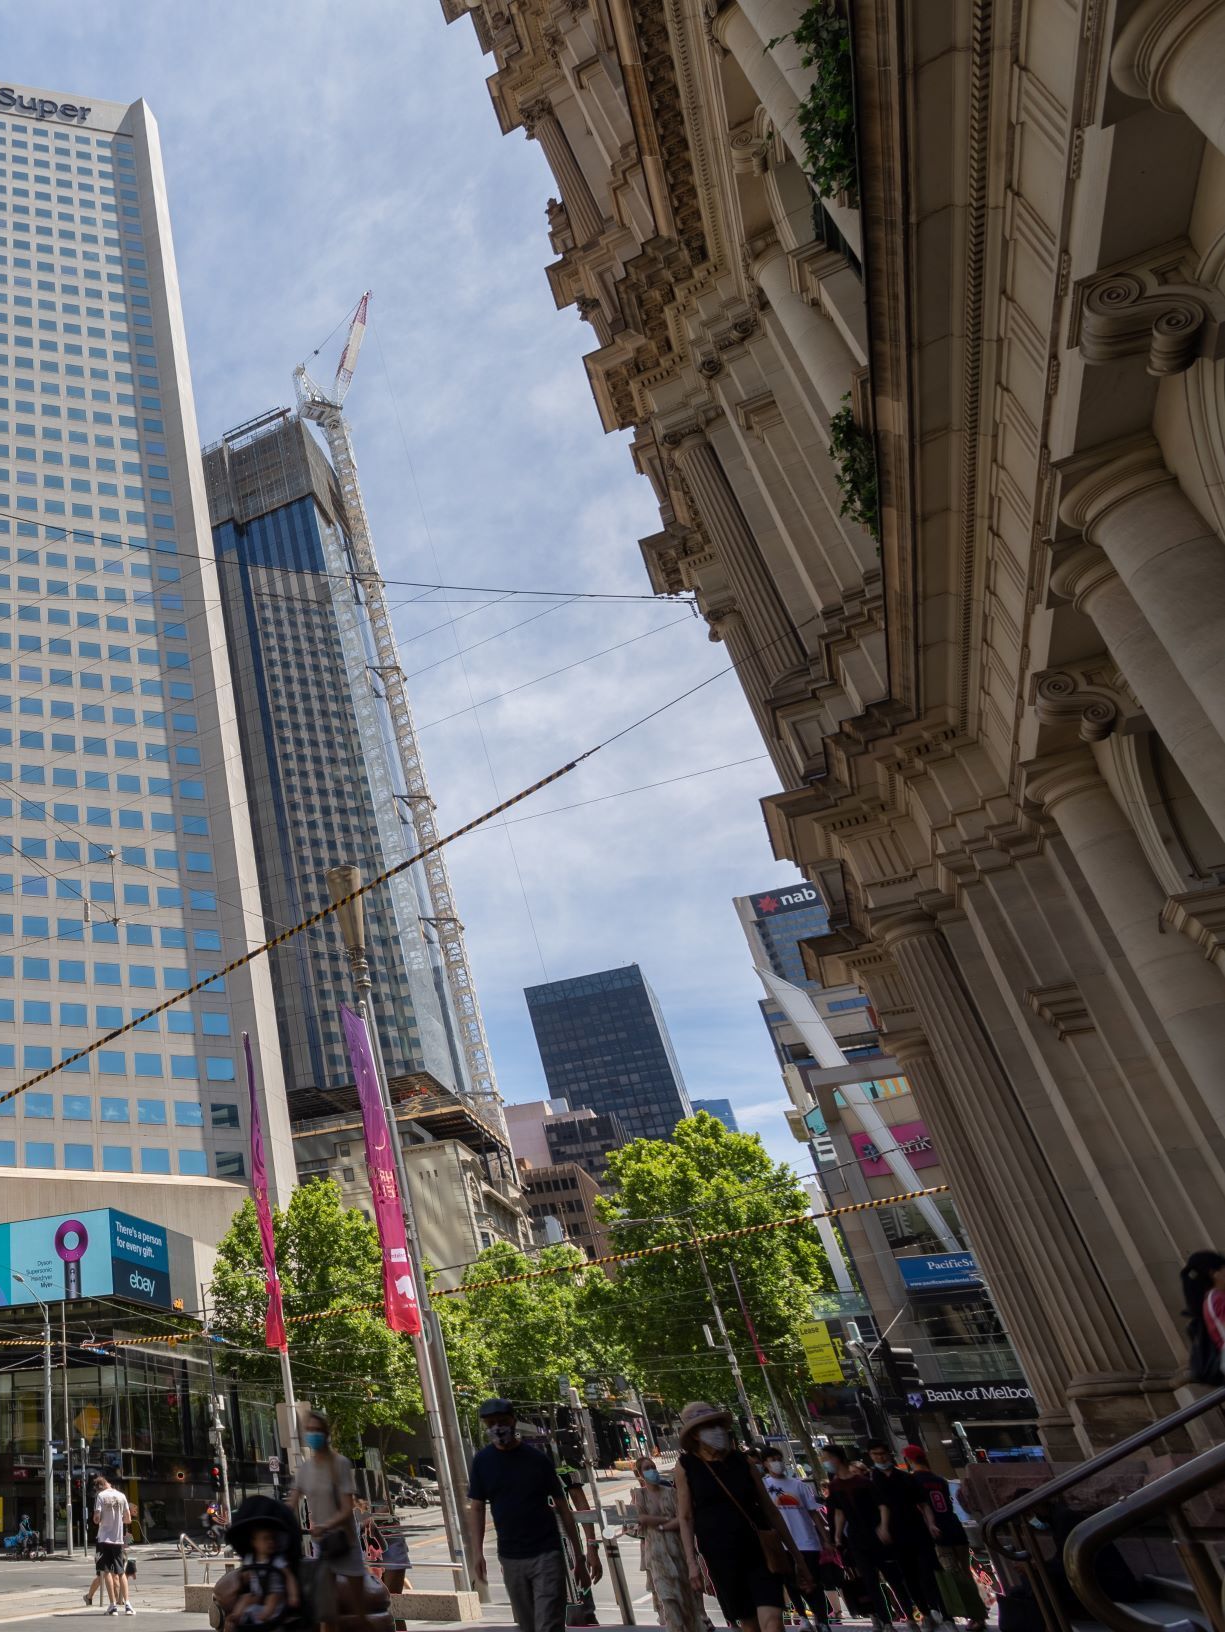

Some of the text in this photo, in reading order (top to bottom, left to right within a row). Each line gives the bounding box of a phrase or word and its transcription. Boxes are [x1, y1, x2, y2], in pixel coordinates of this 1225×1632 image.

[780, 888, 817, 906] nab
[115, 1221, 137, 1238] There's
[143, 1233, 163, 1247] person
[117, 1236, 155, 1258] for every gift.
[26, 1267, 52, 1275] Supersonic
[129, 1270, 155, 1297] ebay
[925, 1388, 965, 1402] Bank
[965, 1387, 978, 1400] of
